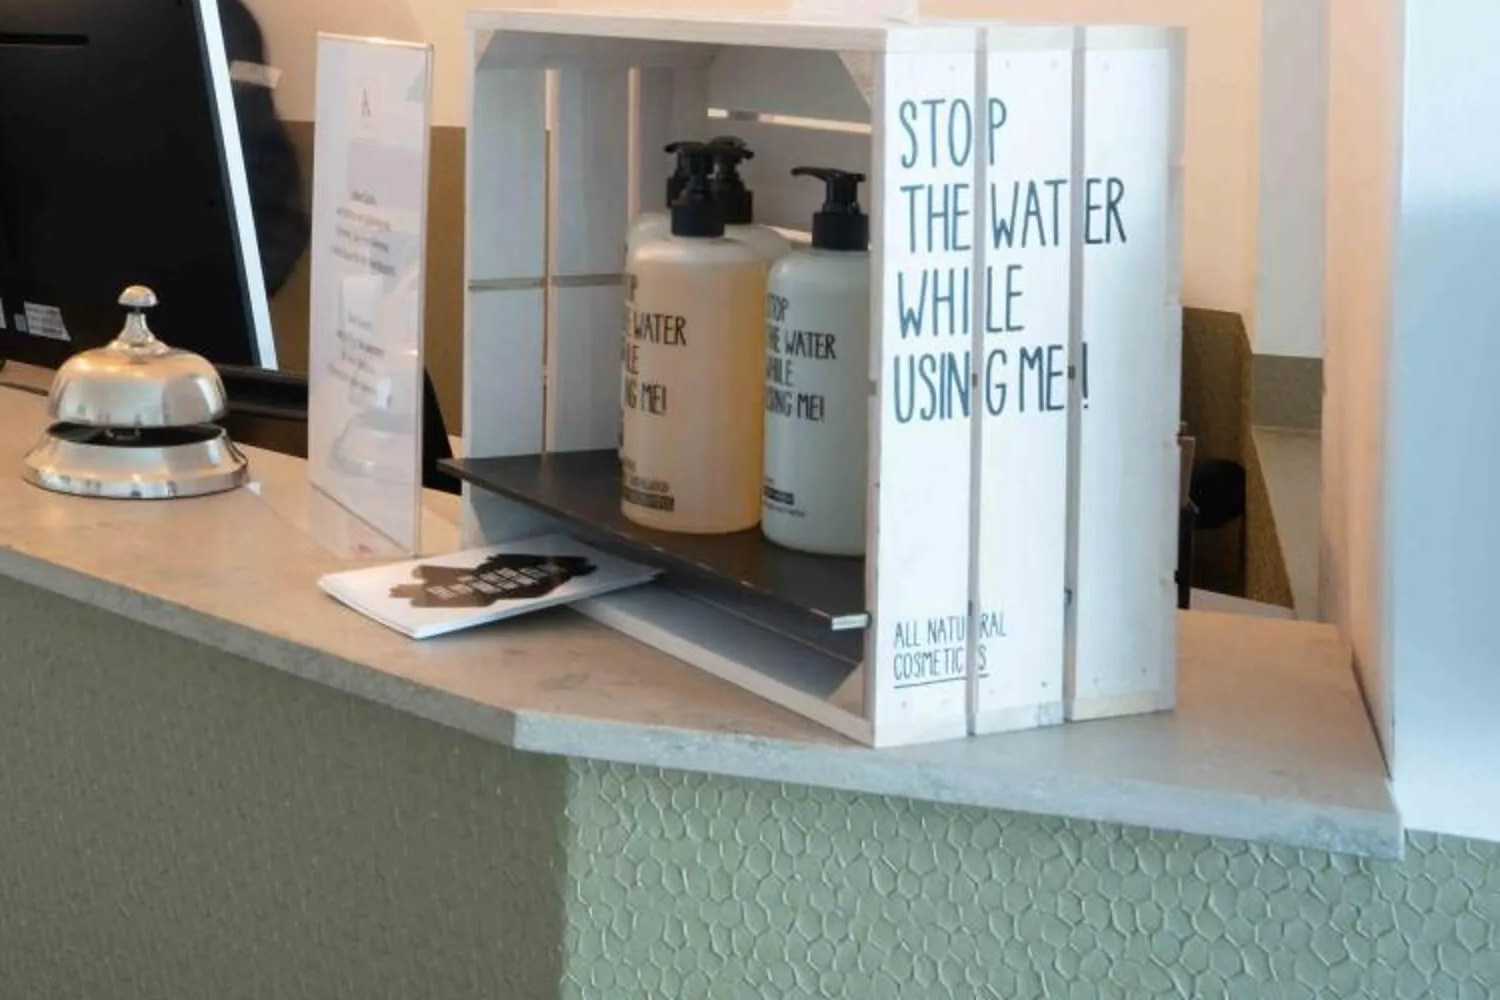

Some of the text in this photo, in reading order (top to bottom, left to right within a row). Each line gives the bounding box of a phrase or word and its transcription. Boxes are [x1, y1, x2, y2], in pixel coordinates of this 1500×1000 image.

[899, 97, 1007, 169] STOP
[900, 177, 1127, 254] THE WATER
[898, 264, 1024, 339] WHILE
[633, 311, 687, 346] WATER
[784, 329, 836, 360] WATER
[641, 382, 667, 416] ME!
[893, 341, 1090, 424] USING ME!
[797, 393, 825, 424] ME!
[893, 609, 1007, 649] ALL NATURAL
[893, 645, 988, 680] COSMETICS
